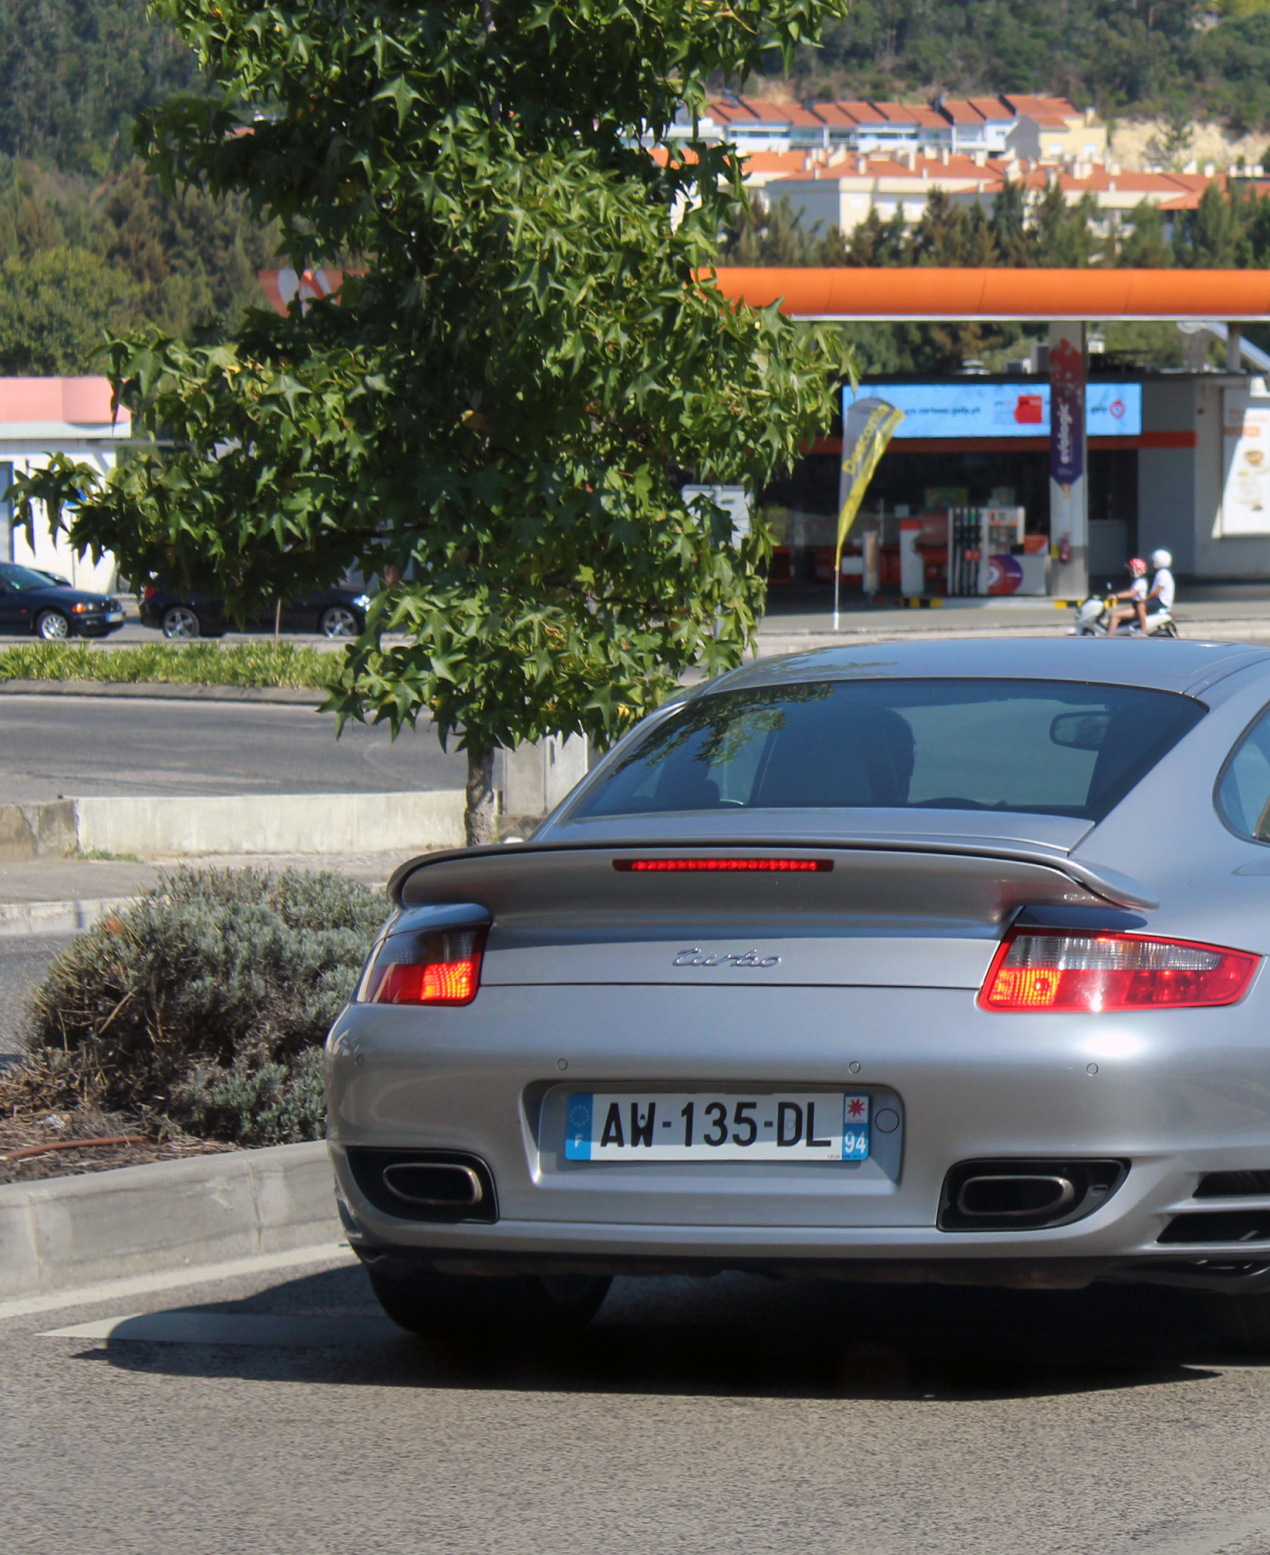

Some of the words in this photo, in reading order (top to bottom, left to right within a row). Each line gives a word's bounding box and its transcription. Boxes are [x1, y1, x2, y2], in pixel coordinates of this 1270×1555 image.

[841, 404, 890, 476] Desconto
[574, 1133, 584, 1149] F
[600, 1101, 832, 1148] AW-135-DL
[844, 1130, 867, 1155] 94
